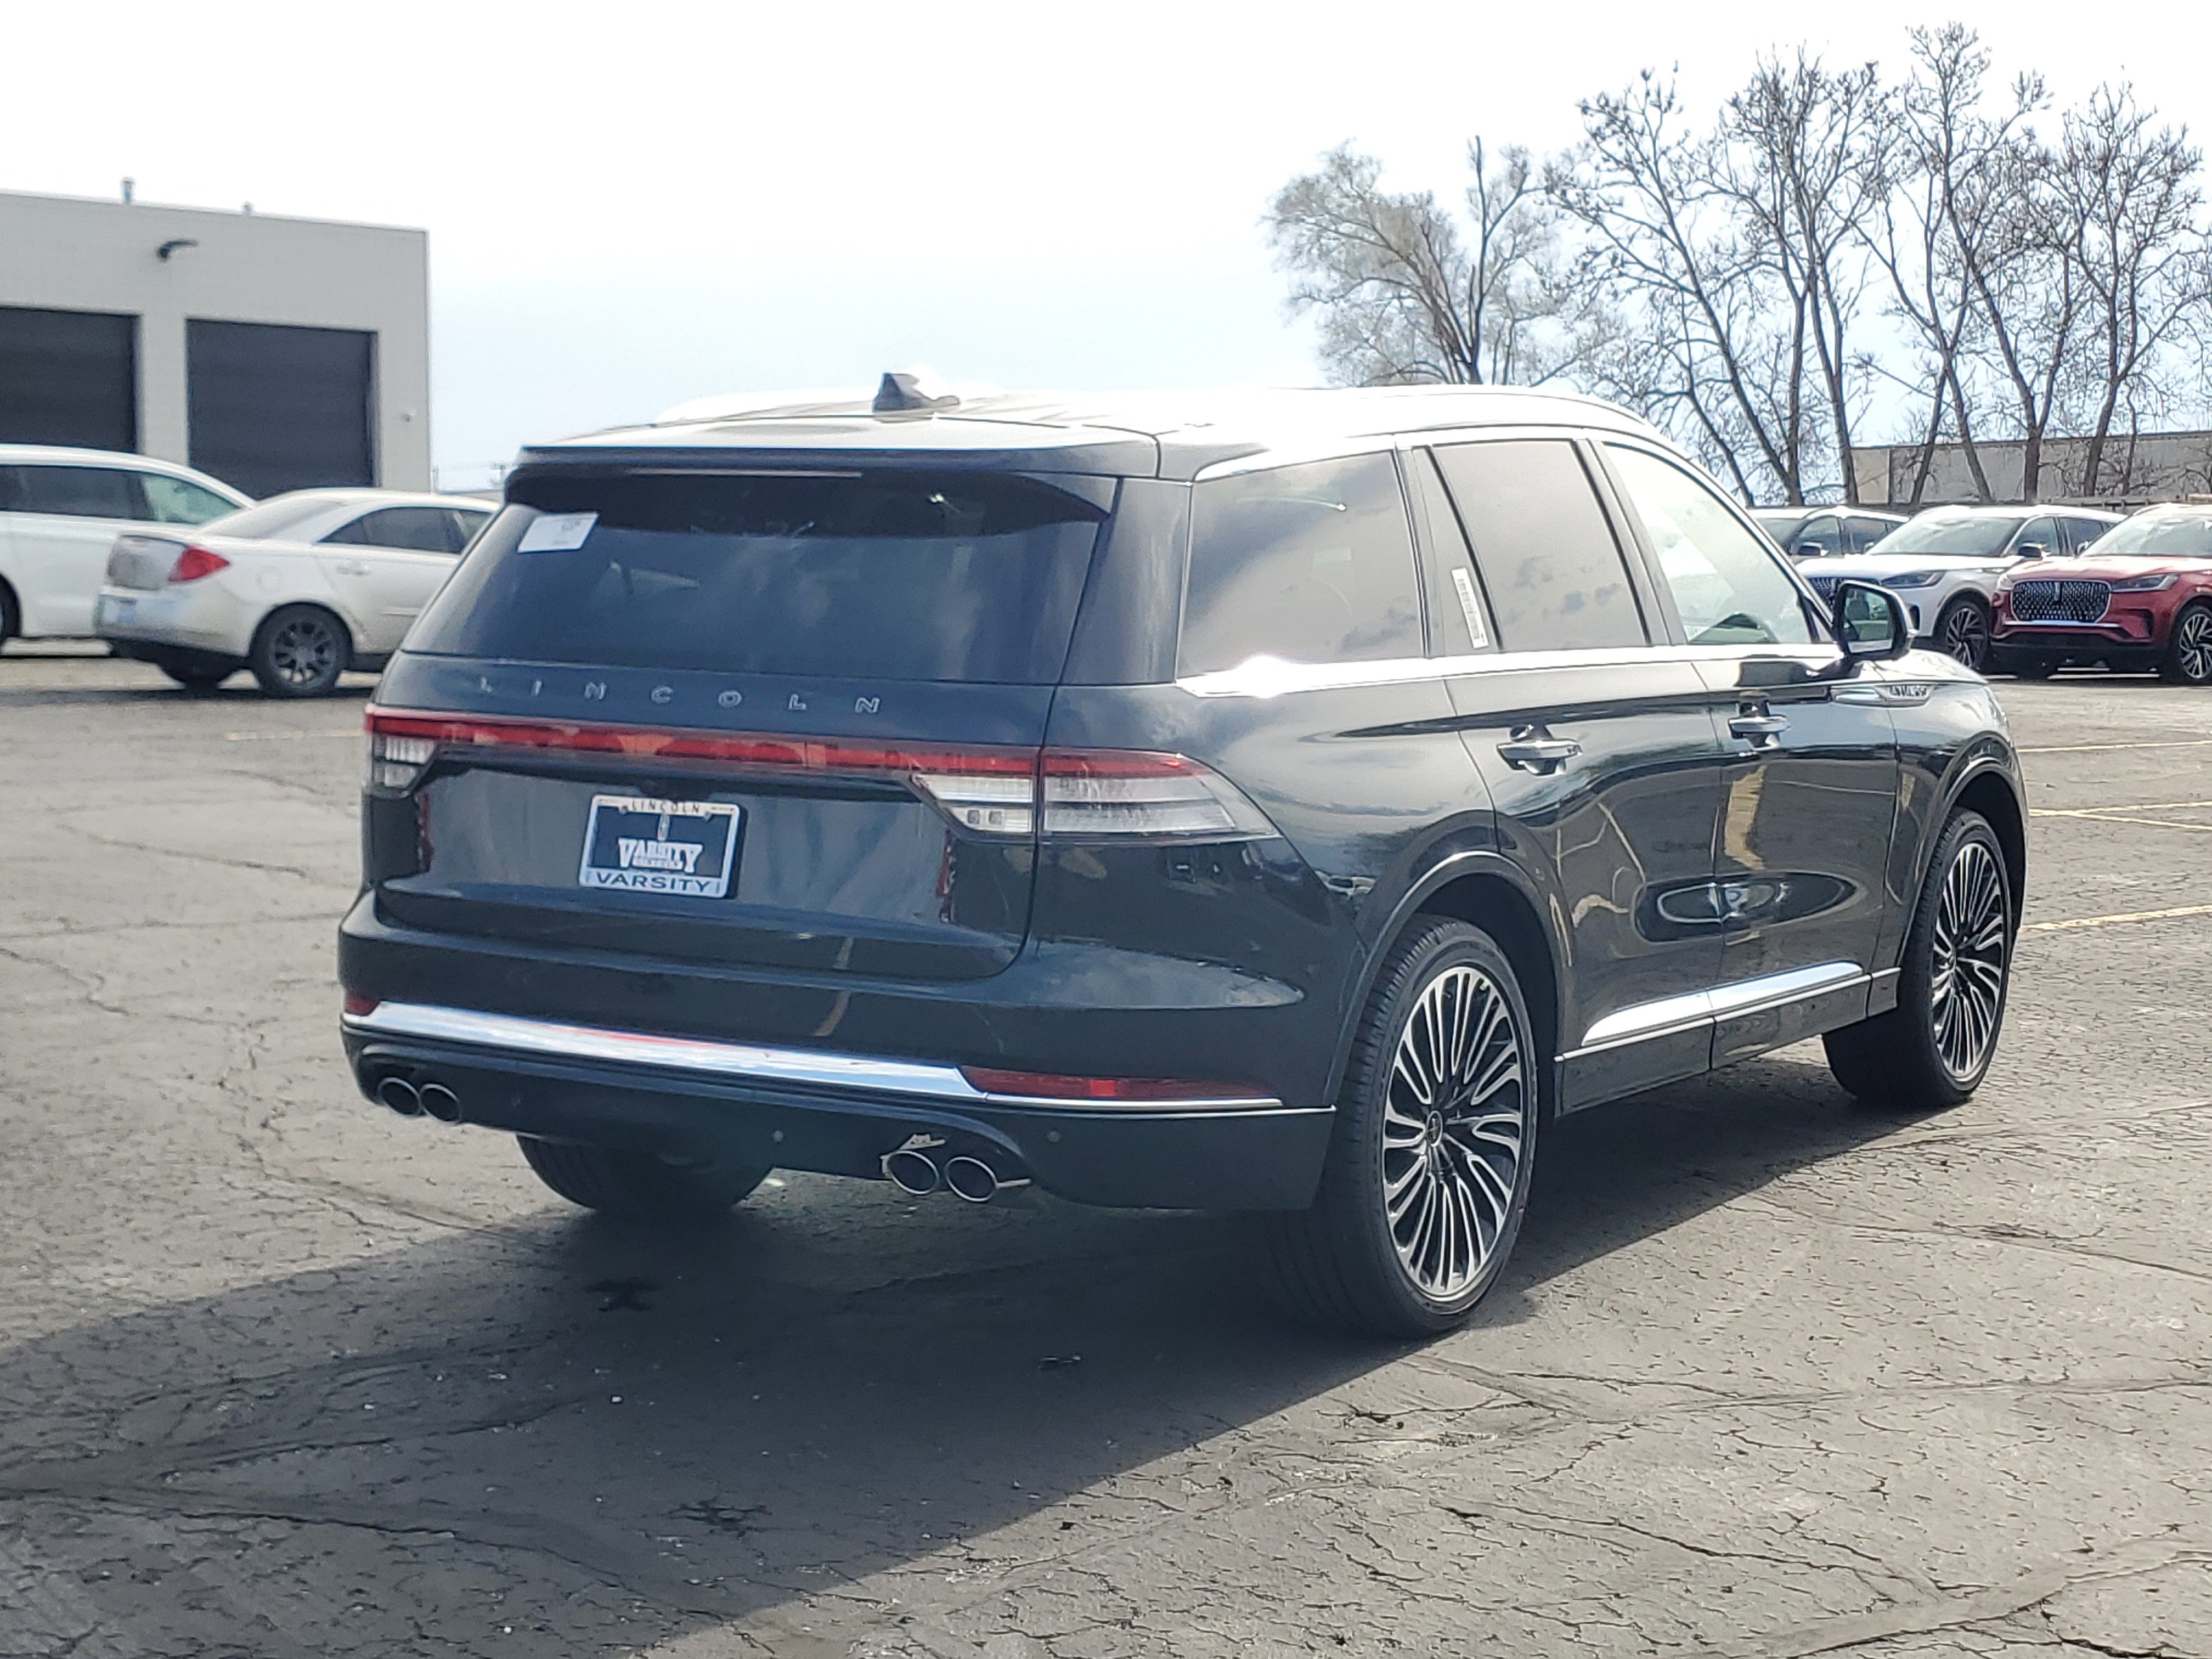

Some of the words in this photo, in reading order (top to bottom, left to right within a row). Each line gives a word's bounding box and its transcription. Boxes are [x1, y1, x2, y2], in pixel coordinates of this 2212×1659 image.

[480, 676, 880, 713] LINCOLN
[632, 799, 700, 813] LINCOLN
[596, 872, 712, 893] VARSITY
